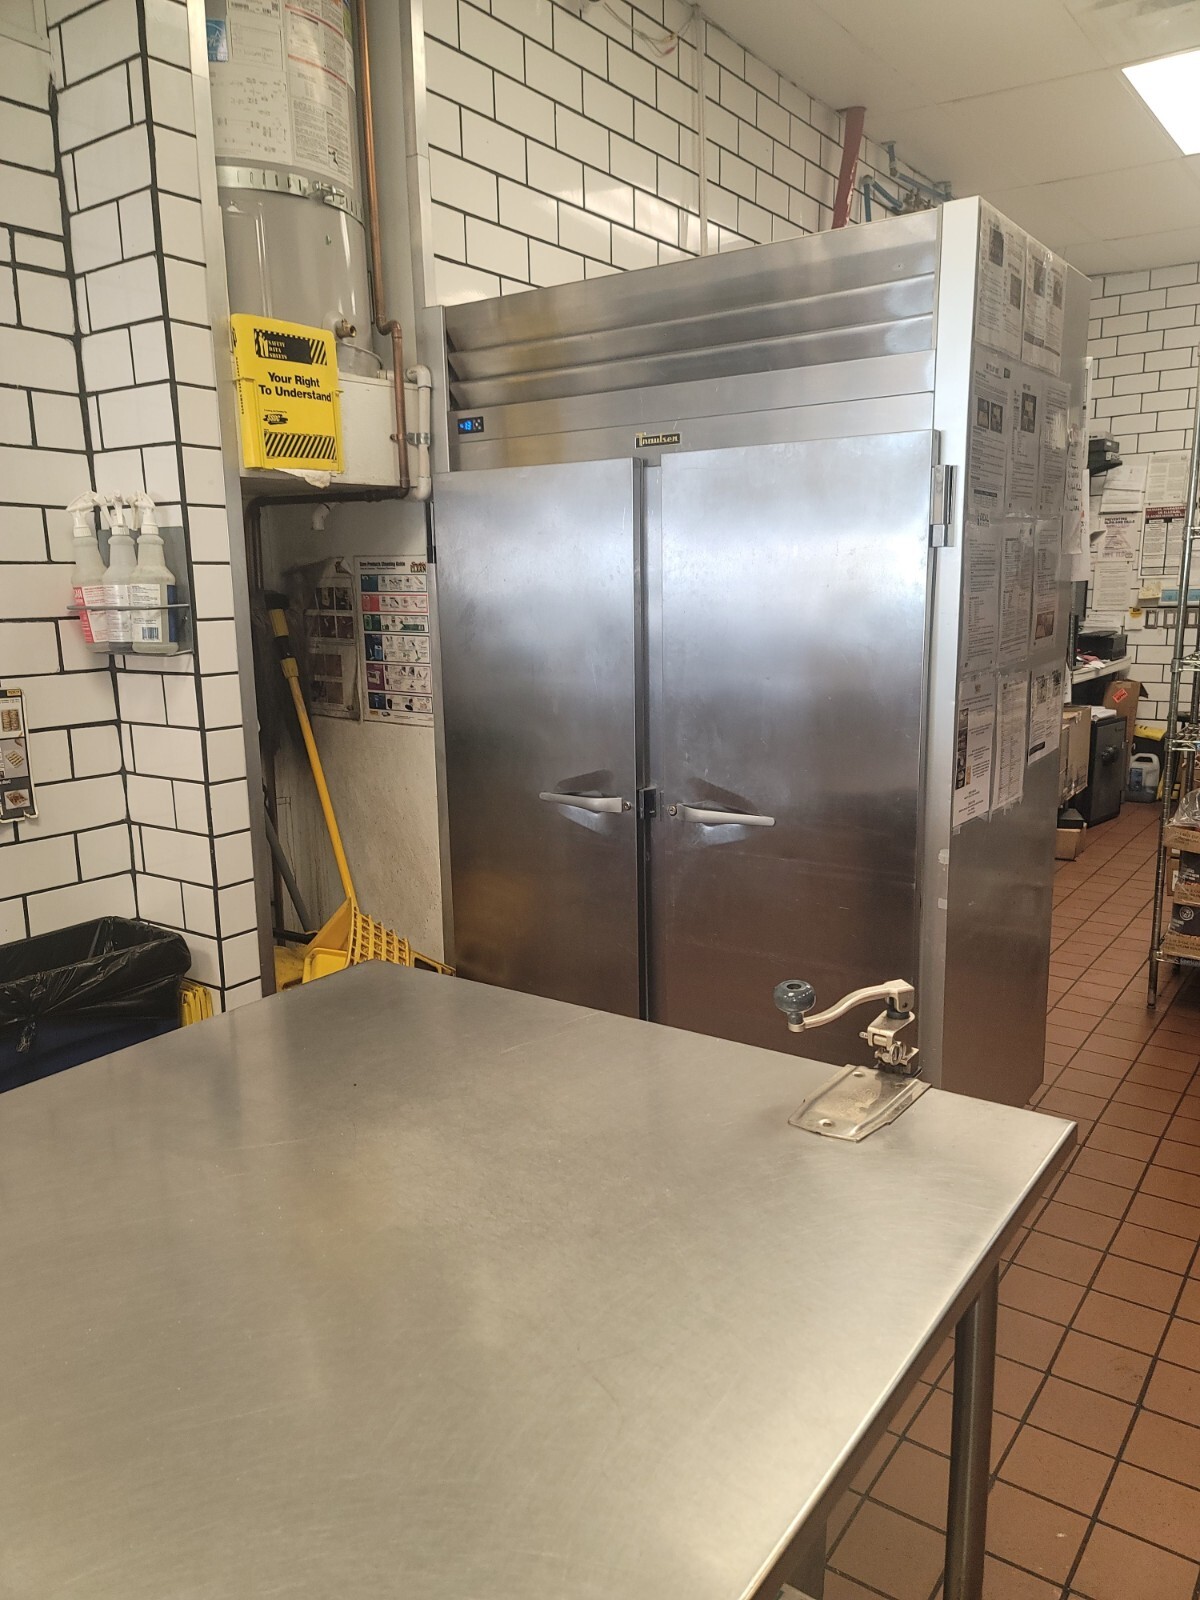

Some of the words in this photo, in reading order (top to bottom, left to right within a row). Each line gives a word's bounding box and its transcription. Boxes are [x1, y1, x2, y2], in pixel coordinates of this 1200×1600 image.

[268, 371, 292, 384] Your
[294, 374, 320, 388] Right
[258, 384, 272, 395] To
[275, 386, 332, 402] Understand
